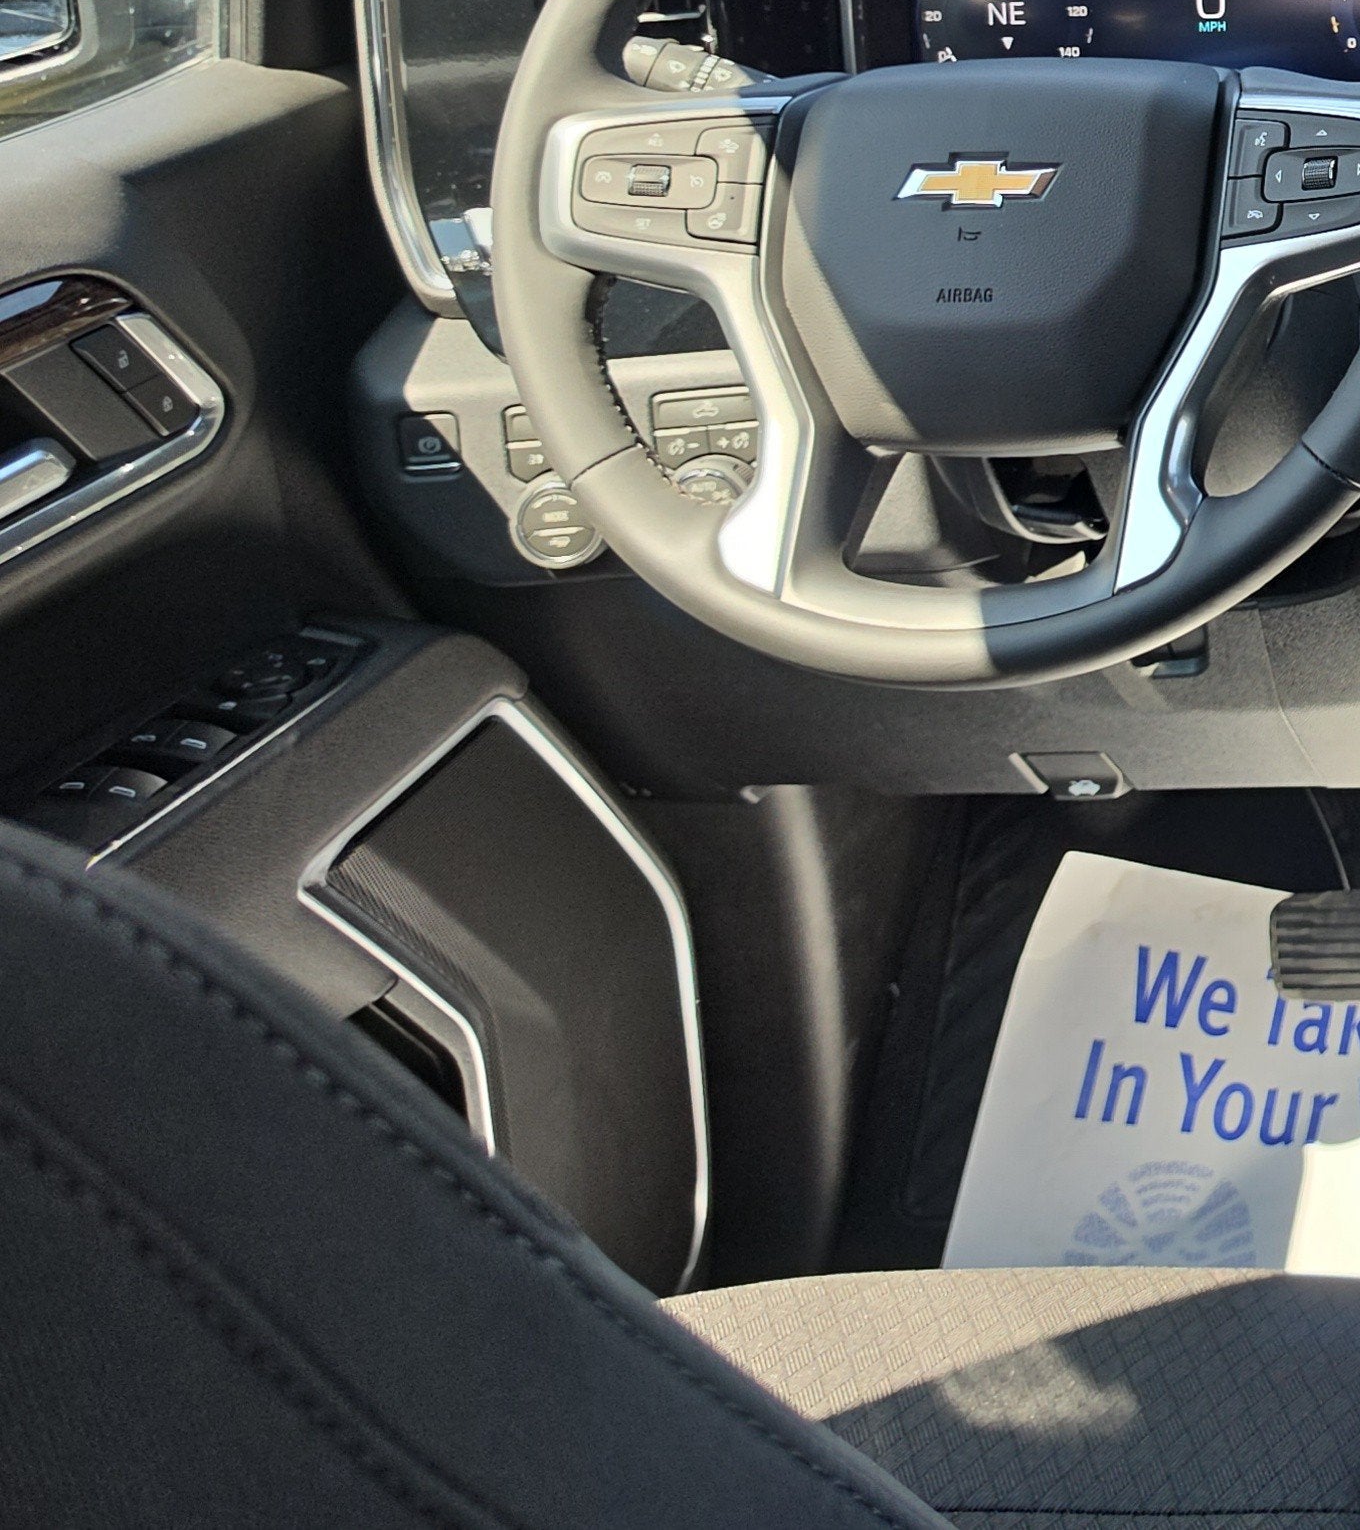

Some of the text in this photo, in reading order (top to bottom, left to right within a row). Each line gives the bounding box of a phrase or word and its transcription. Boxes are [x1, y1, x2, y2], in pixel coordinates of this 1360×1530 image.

[924, 10, 943, 22] 20
[987, 1, 1026, 26] NE
[1066, 6, 1088, 17] 120
[1199, 21, 1226, 32] MPH
[1346, 37, 1357, 49] 0
[1058, 46, 1080, 57] 140
[936, 288, 993, 303] AIRBAG
[1135, 945, 1237, 1037] We
[1074, 1039, 1147, 1126] In
[1179, 1052, 1340, 1148] Your
